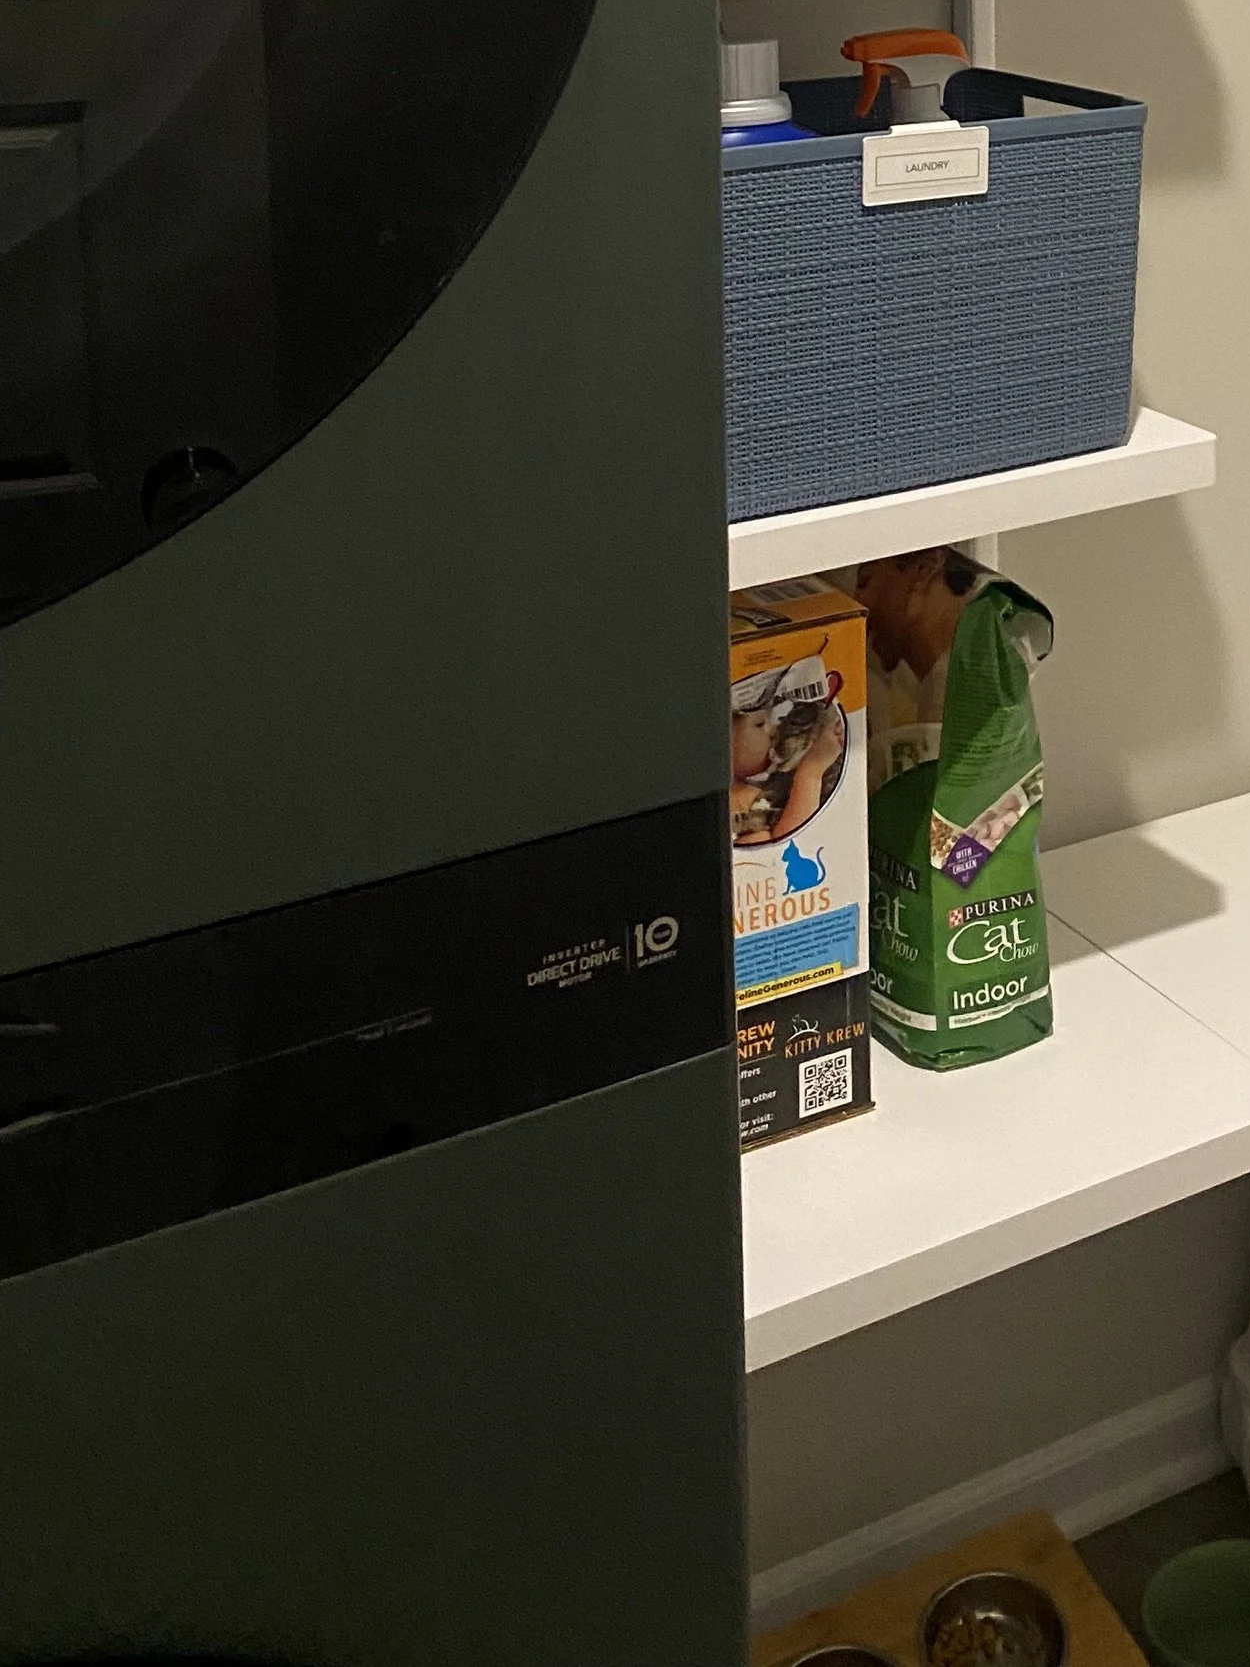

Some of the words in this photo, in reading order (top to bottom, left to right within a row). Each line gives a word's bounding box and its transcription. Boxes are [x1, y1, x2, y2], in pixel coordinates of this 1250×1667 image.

[905, 159, 950, 173] LAUNDRY
[952, 859, 977, 875] CHICKEN
[964, 892, 1035, 920] PURINA
[946, 918, 1031, 965] Cat
[1000, 942, 1039, 962] Chow
[527, 959, 578, 986] DIRECT
[580, 945, 622, 971] DRIVE
[953, 976, 1028, 1010] Indoor
[785, 1035, 822, 1059] KITTY
[826, 1021, 865, 1046] KREW
[752, 1090, 777, 1103] other
